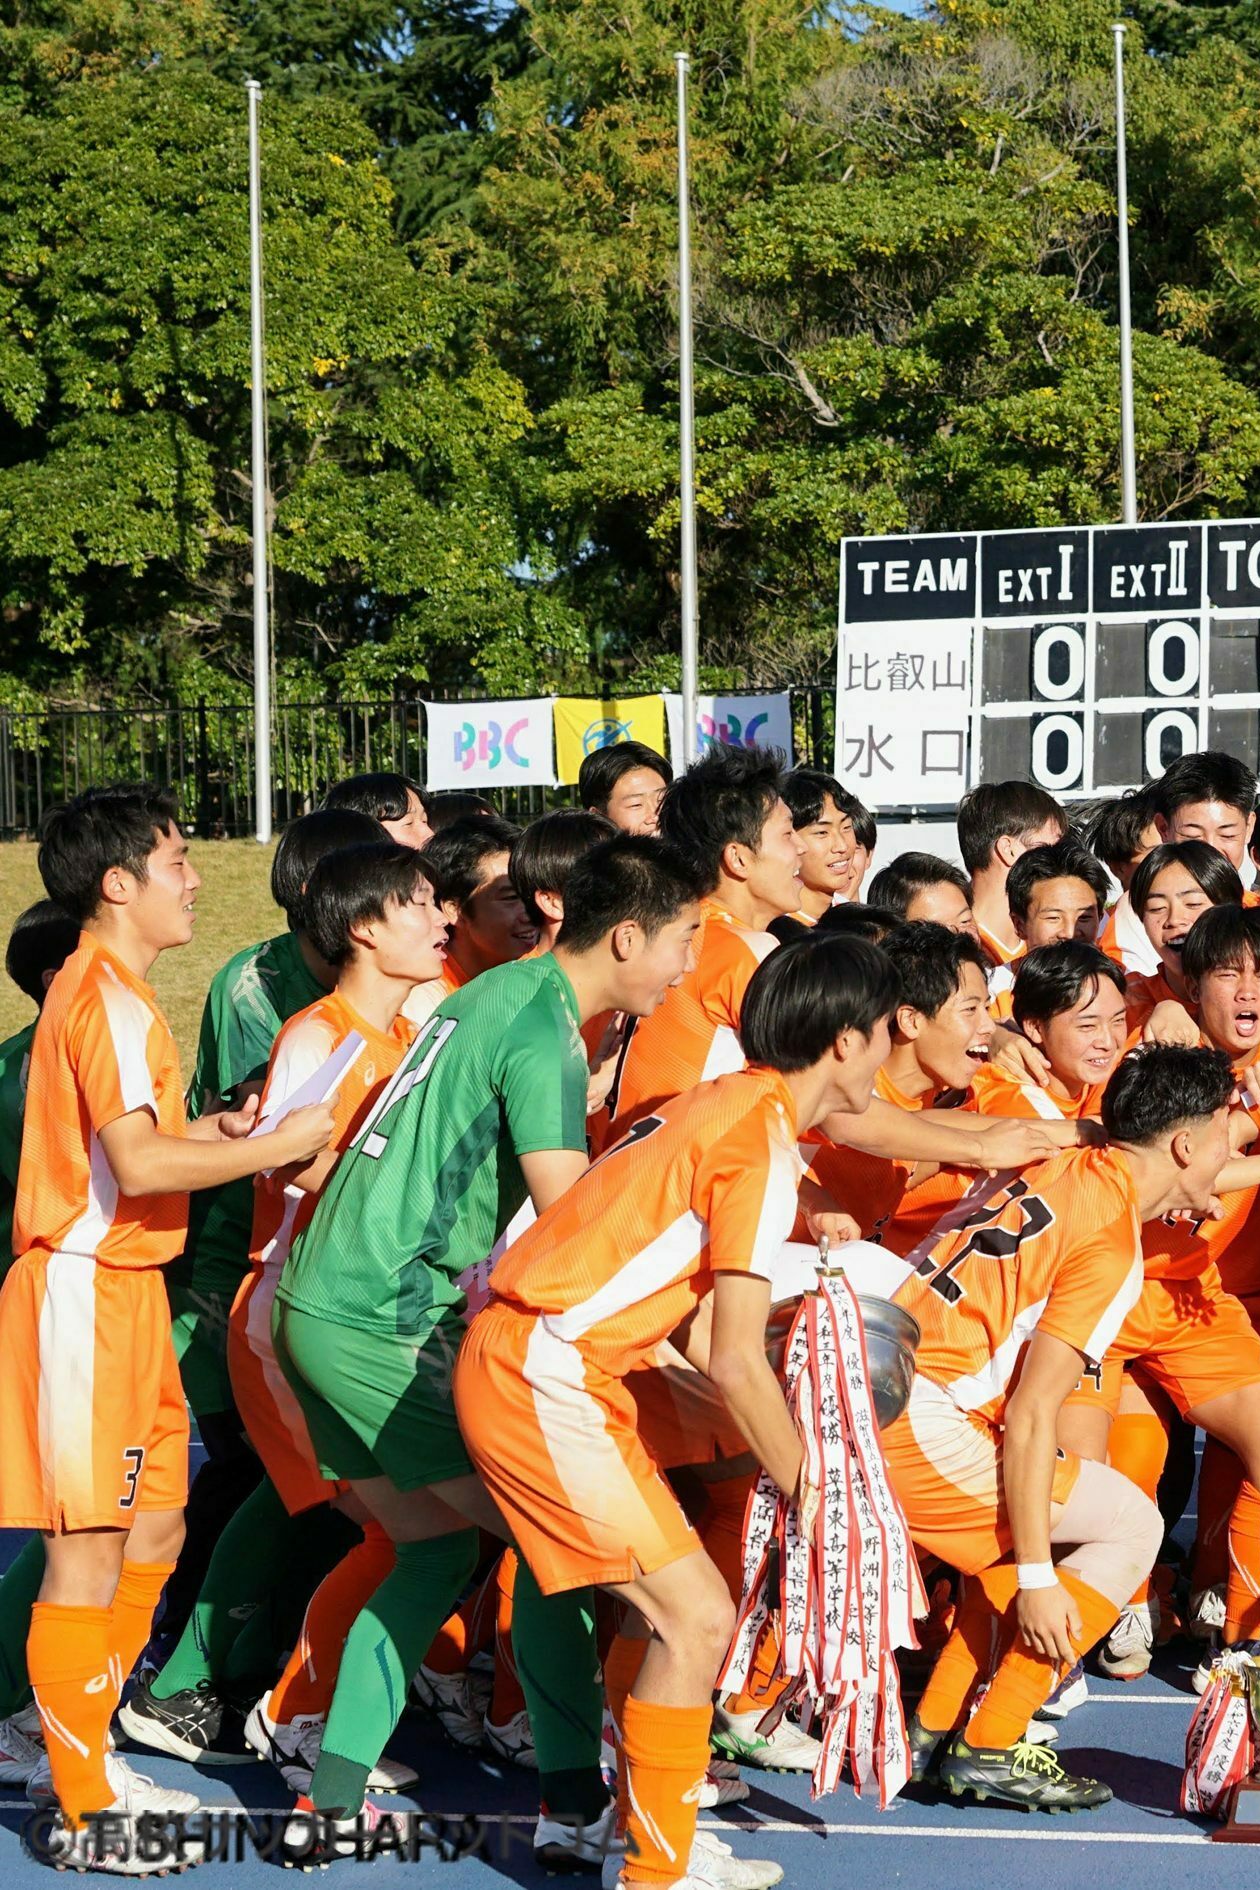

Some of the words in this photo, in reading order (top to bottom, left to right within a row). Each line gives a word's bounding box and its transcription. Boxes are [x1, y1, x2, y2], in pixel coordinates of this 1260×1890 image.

[857, 558, 968, 594] TEAM
[843, 650, 967, 692] 比叡山
[1033, 625, 1085, 700] 0
[1148, 620, 1200, 696] 0
[453, 717, 530, 771] BBC
[844, 724, 965, 777] 水口
[1032, 714, 1084, 790] 0
[1145, 710, 1199, 779] 0
[846, 1352, 866, 1390] 優勝
[820, 1394, 847, 1446] 優勝
[117, 1445, 146, 1509] 3
[821, 1467, 849, 1632] 草津東高等学校
